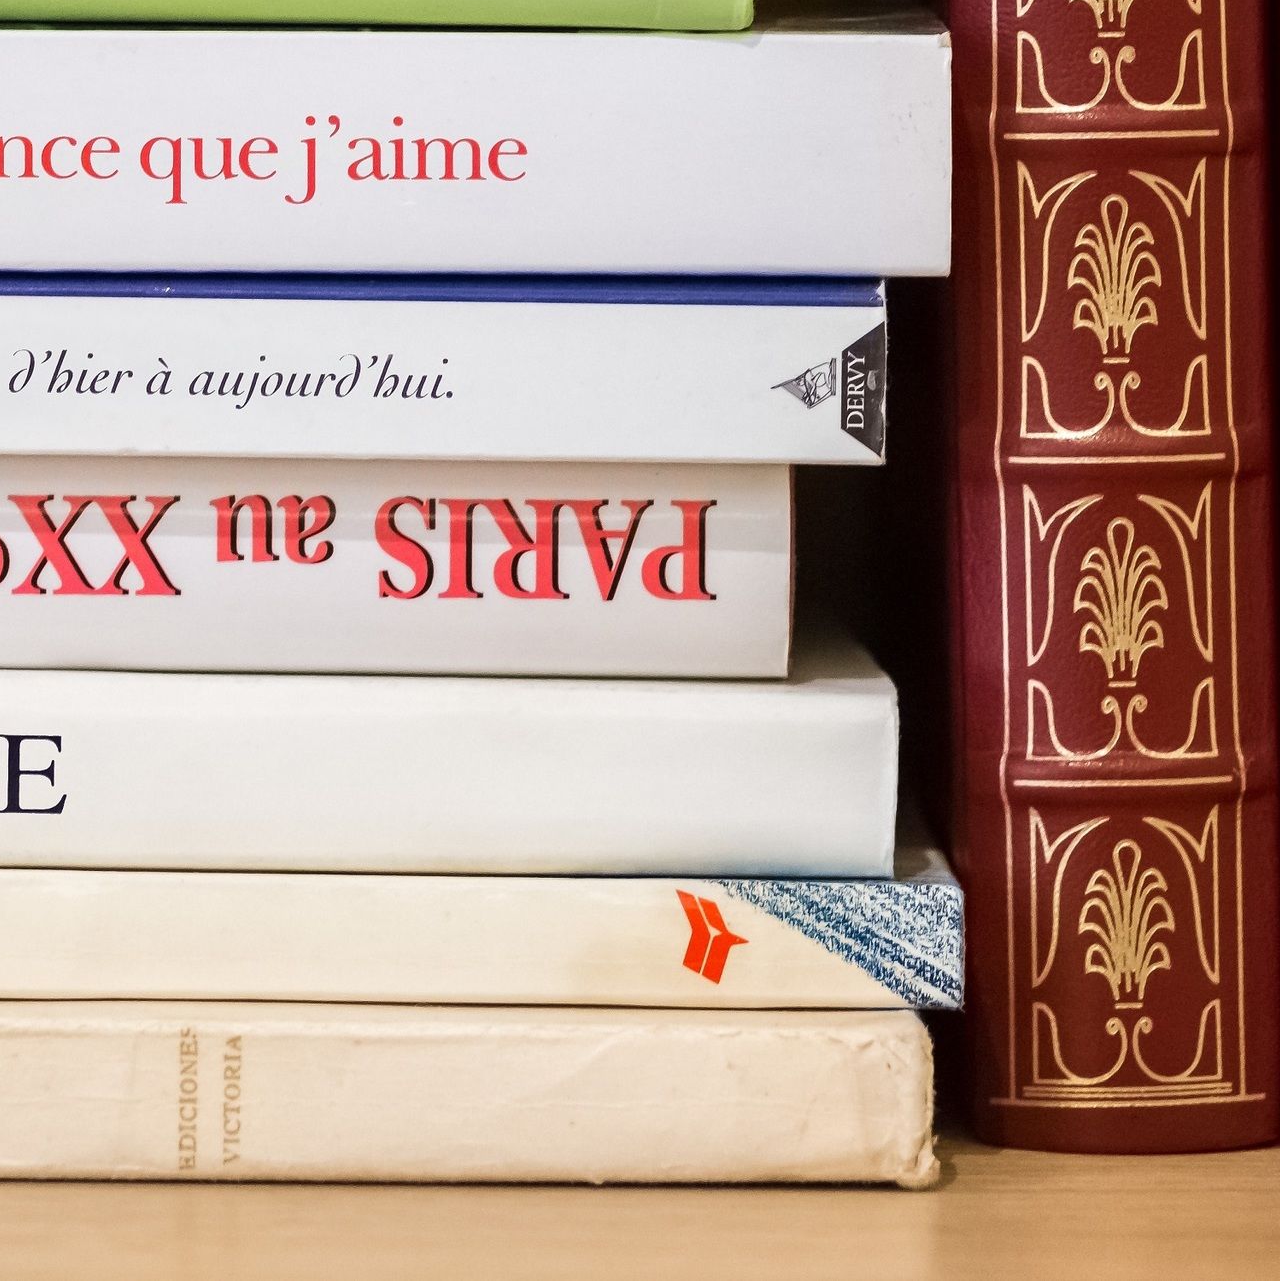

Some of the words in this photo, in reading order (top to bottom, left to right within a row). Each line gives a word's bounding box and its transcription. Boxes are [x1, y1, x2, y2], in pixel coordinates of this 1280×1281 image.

[140, 137, 278, 204] que
[147, 358, 171, 394] à
[847, 352, 865, 428] DERVY
[209, 494, 337, 564] au
[374, 496, 718, 601] PARIS
[223, 1035, 242, 1165] VICTORIA
